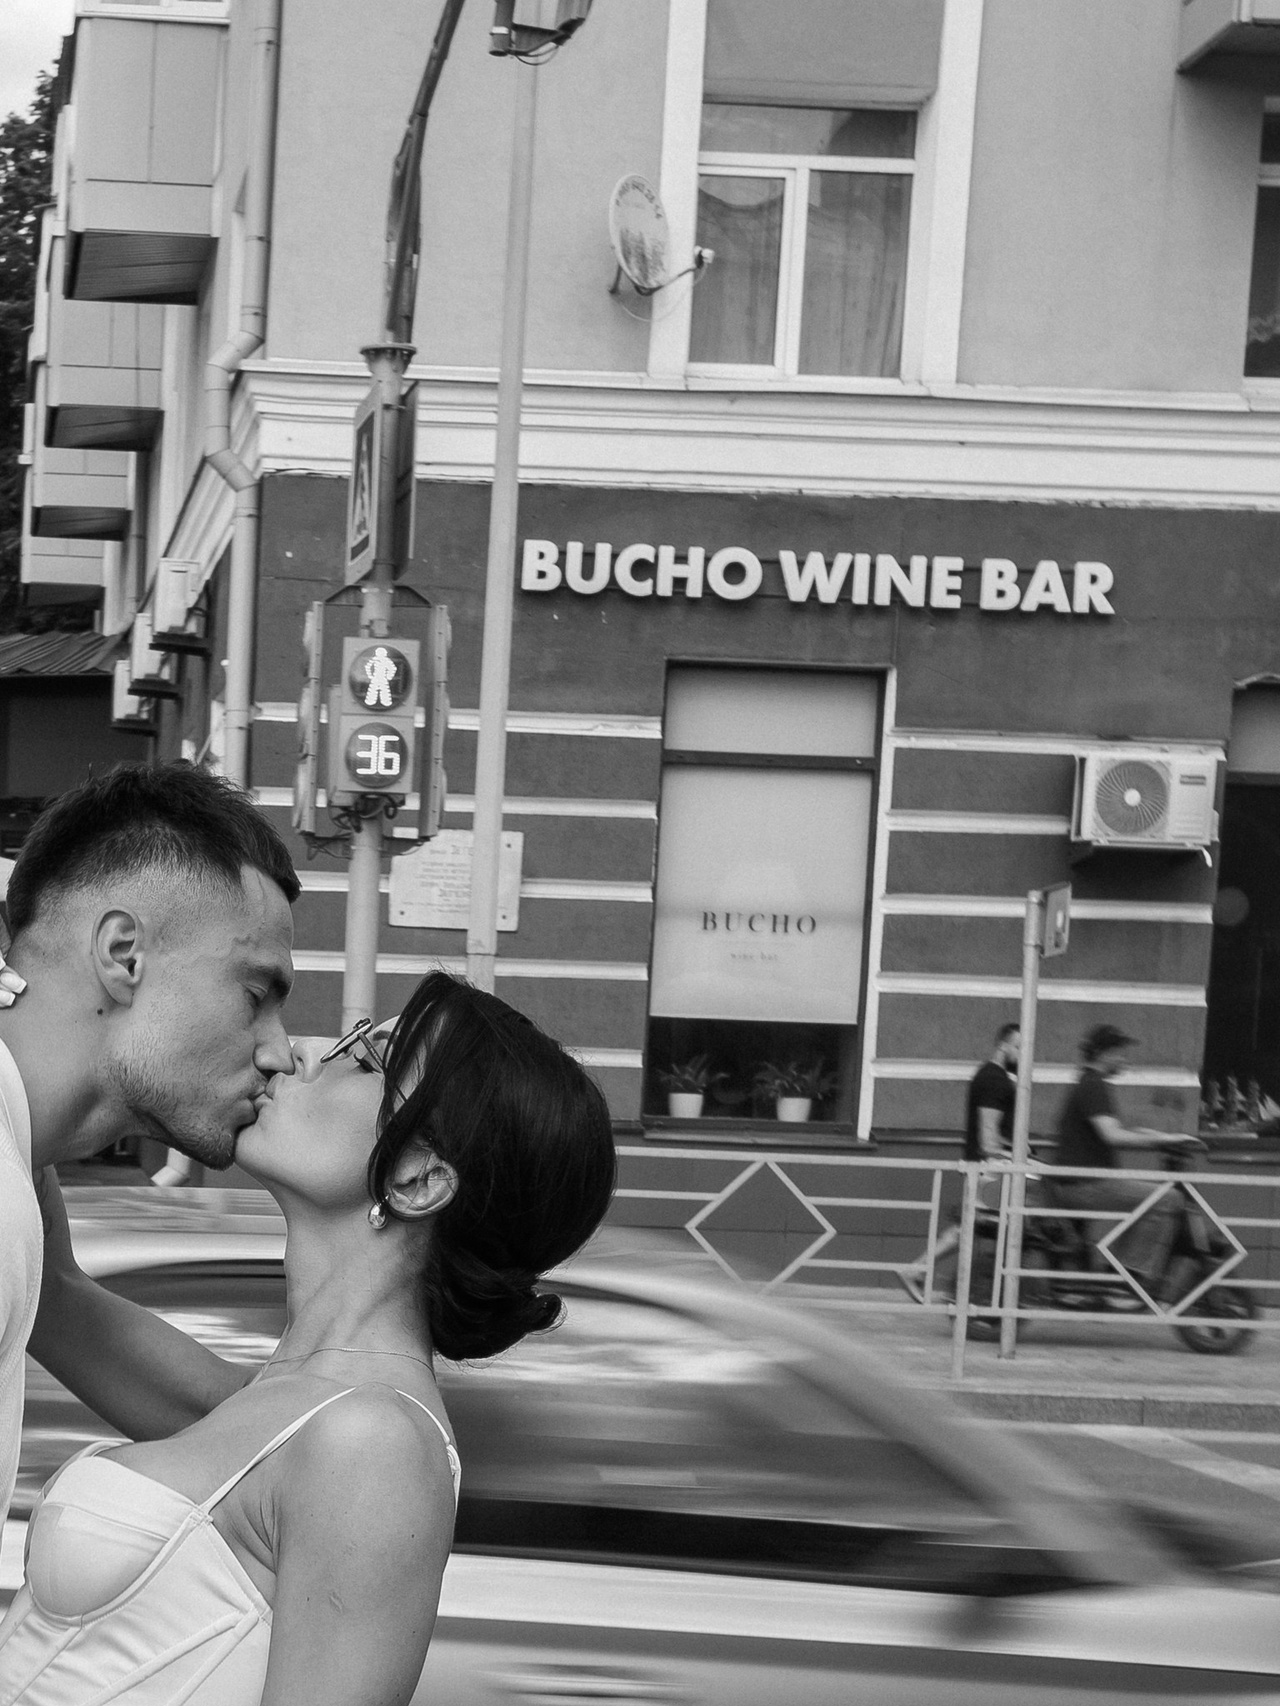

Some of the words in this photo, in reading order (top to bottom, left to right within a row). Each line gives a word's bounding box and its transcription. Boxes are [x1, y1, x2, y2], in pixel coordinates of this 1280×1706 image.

[521, 539, 763, 600] BUCHO
[778, 550, 964, 609] WINE
[979, 558, 1115, 614] BAR
[356, 734, 400, 775] 36
[701, 911, 817, 935] BUCHO
